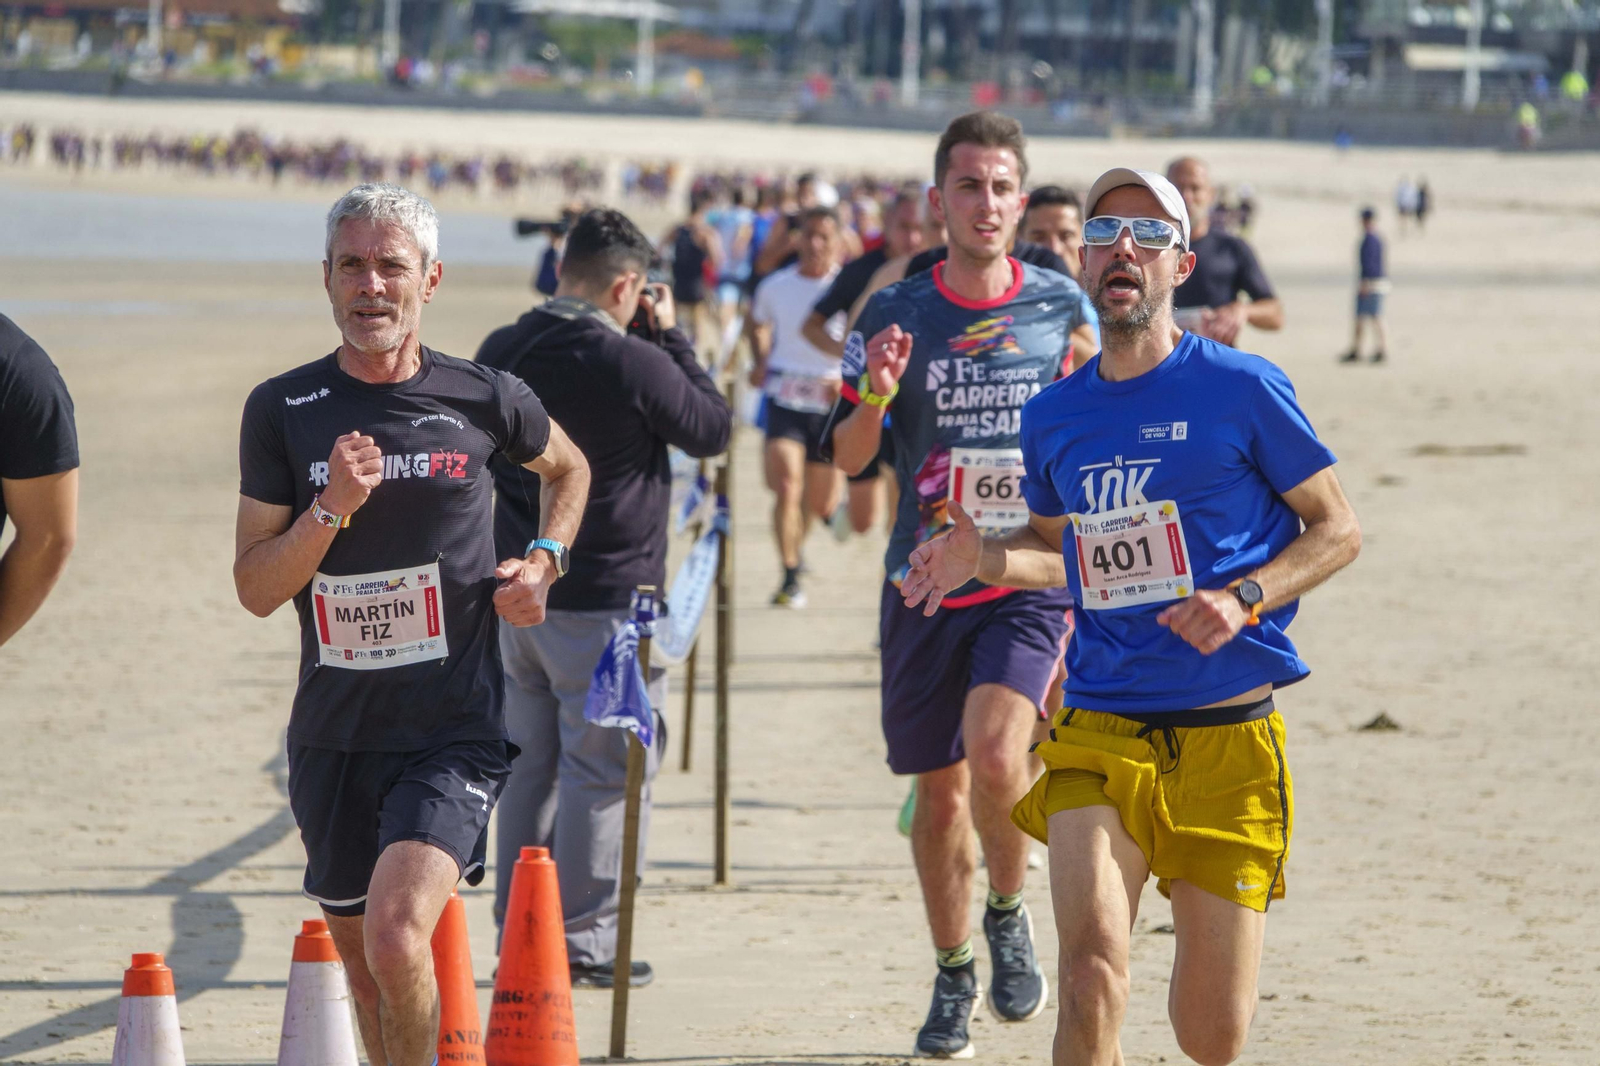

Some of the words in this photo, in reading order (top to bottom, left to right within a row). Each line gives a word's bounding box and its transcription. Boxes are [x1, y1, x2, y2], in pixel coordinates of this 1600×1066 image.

[989, 367, 1039, 385] seguros
[285, 391, 318, 406] luanvi
[936, 413, 978, 427] PRAIA
[962, 424, 979, 438] DE
[1141, 426, 1170, 434] CONCELLO
[1081, 466, 1155, 515] 10K
[1100, 515, 1133, 529] CARREIRA
[1102, 526, 1119, 534] PRAIA
[1092, 536, 1153, 574] 401
[355, 580, 389, 591] CARREIRA
[356, 588, 374, 596] PRAIA
[335, 598, 415, 623] MARTÍN
[360, 622, 393, 641] FIZ
[369, 649, 383, 657] 100
